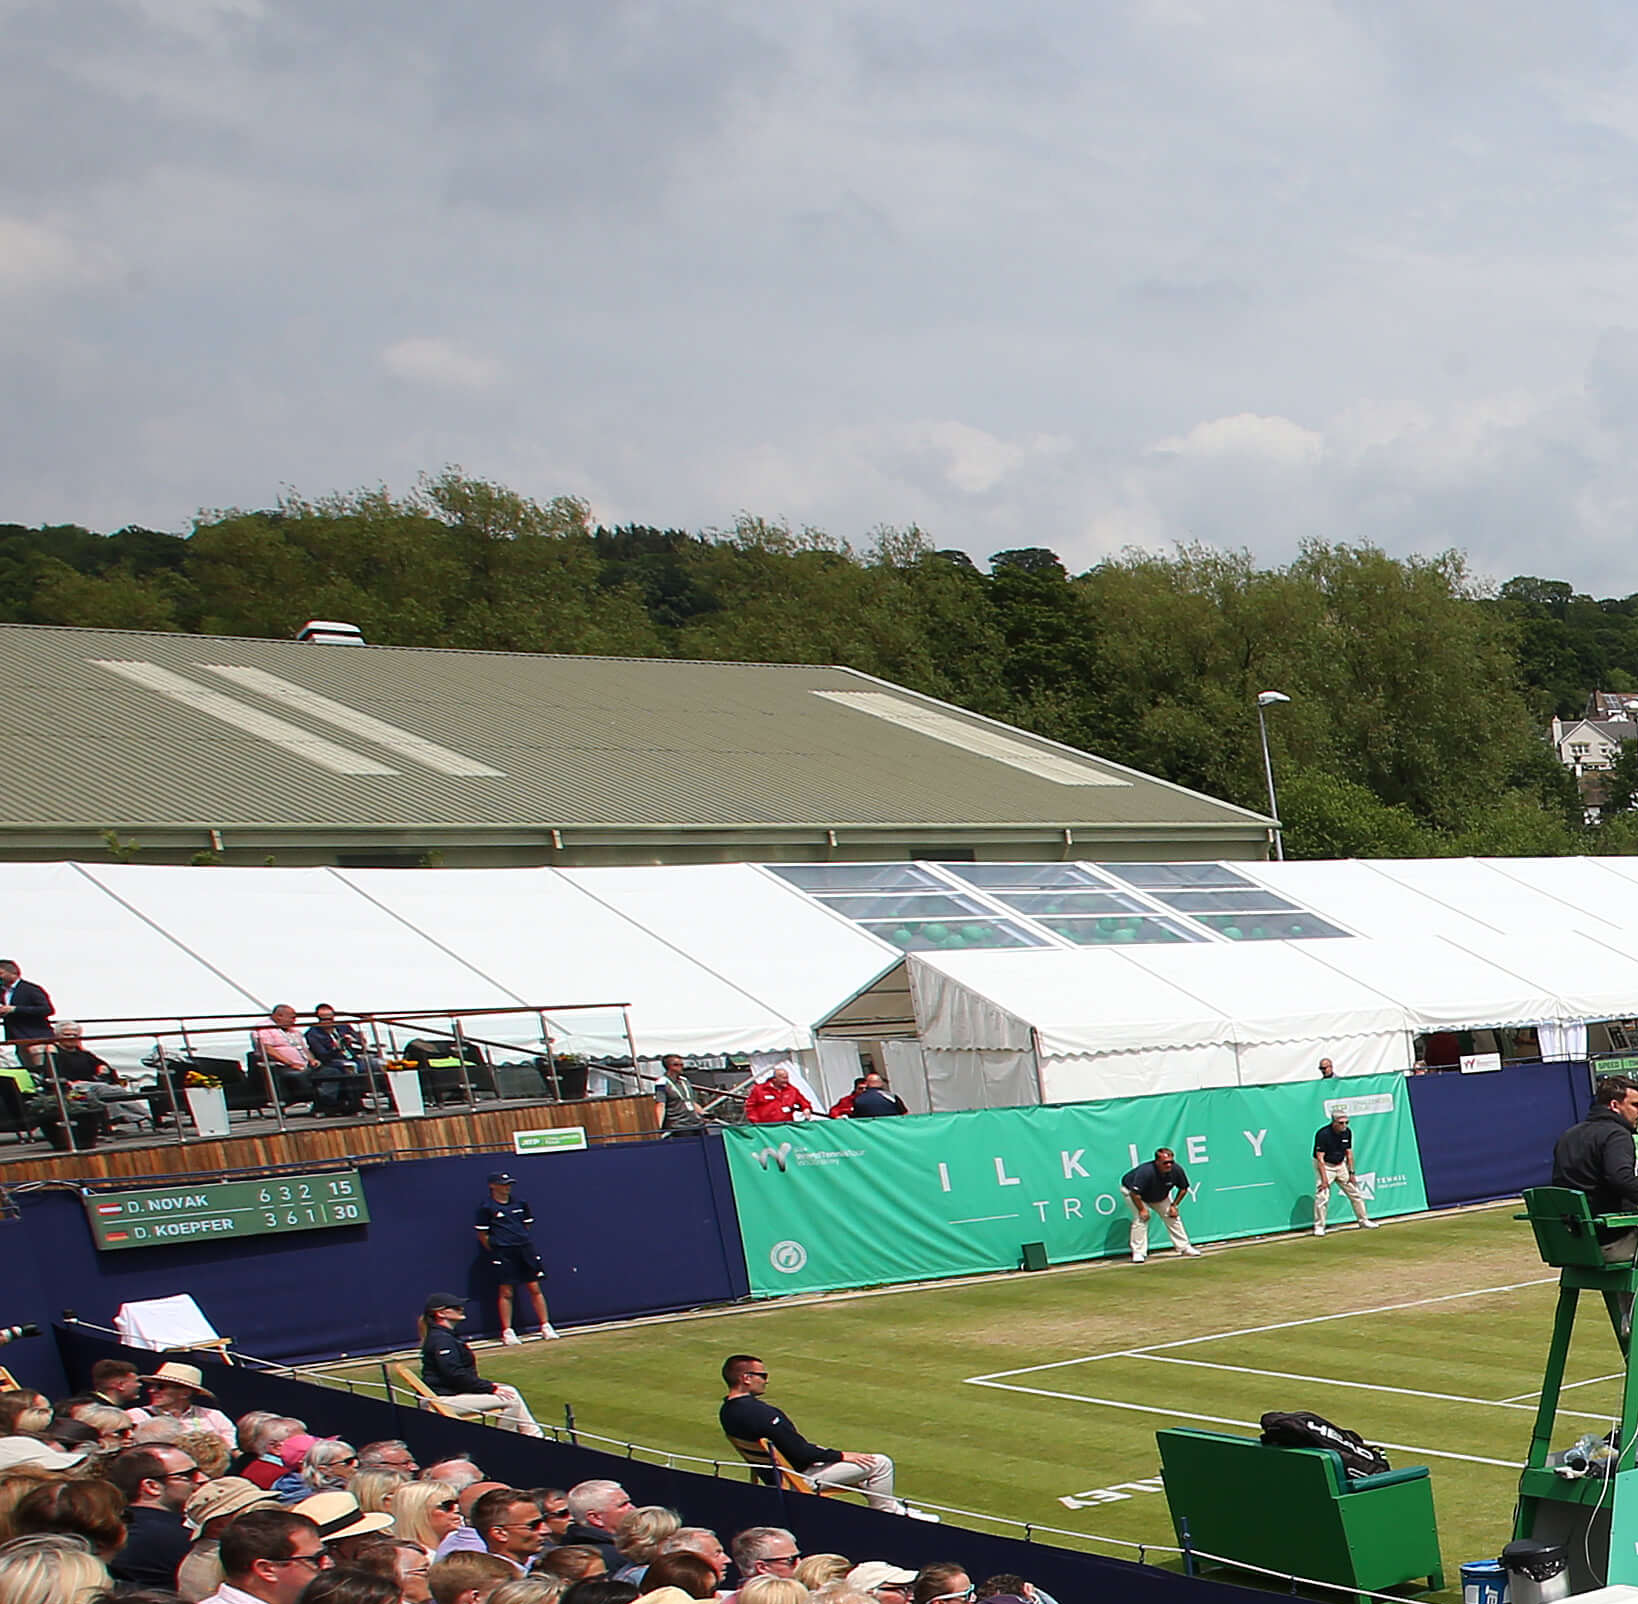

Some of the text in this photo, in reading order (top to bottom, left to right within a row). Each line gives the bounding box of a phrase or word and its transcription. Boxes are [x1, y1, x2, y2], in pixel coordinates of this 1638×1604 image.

[127, 1180, 352, 1214] D. NOVAK 6 3 2 15
[1032, 1181, 1201, 1224] TROY
[134, 1204, 358, 1240] D. KOEPFER 3 6 1 30
[1307, 1420, 1375, 1461] HEAD
